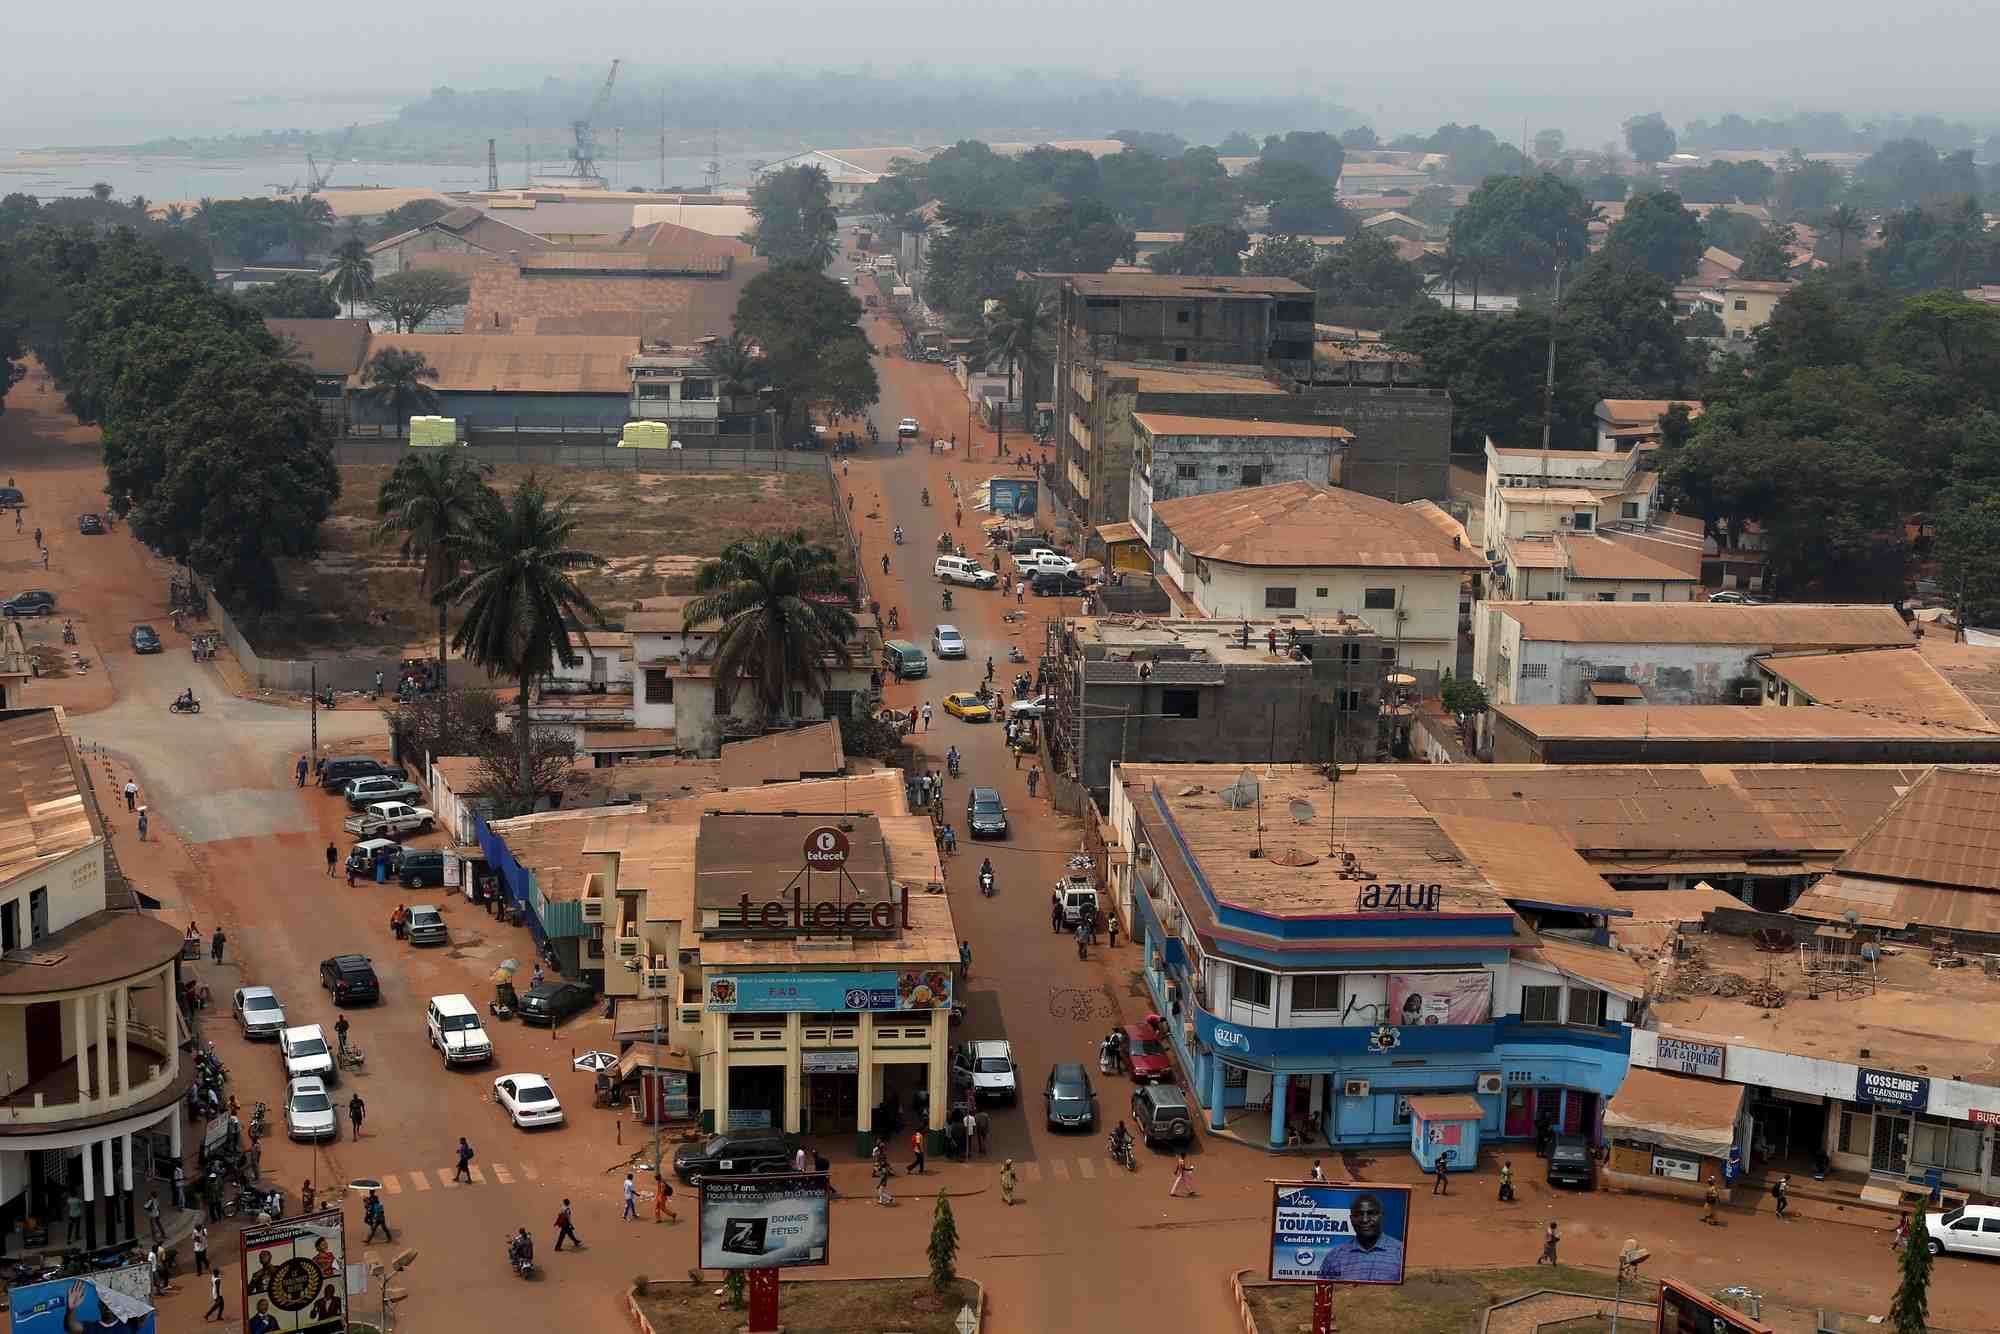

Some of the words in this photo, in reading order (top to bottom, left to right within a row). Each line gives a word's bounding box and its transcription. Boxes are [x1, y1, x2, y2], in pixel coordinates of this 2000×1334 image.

[807, 850, 845, 860] telecel
[1363, 883, 1442, 910] azur
[737, 886, 912, 930] telecel
[1217, 1028, 1243, 1044] azur
[1865, 1073, 1920, 1093] KOSSEMBE
[1867, 1086, 1913, 1101] CHAUSSURES
[1279, 1217, 1350, 1233] TOUADERA
